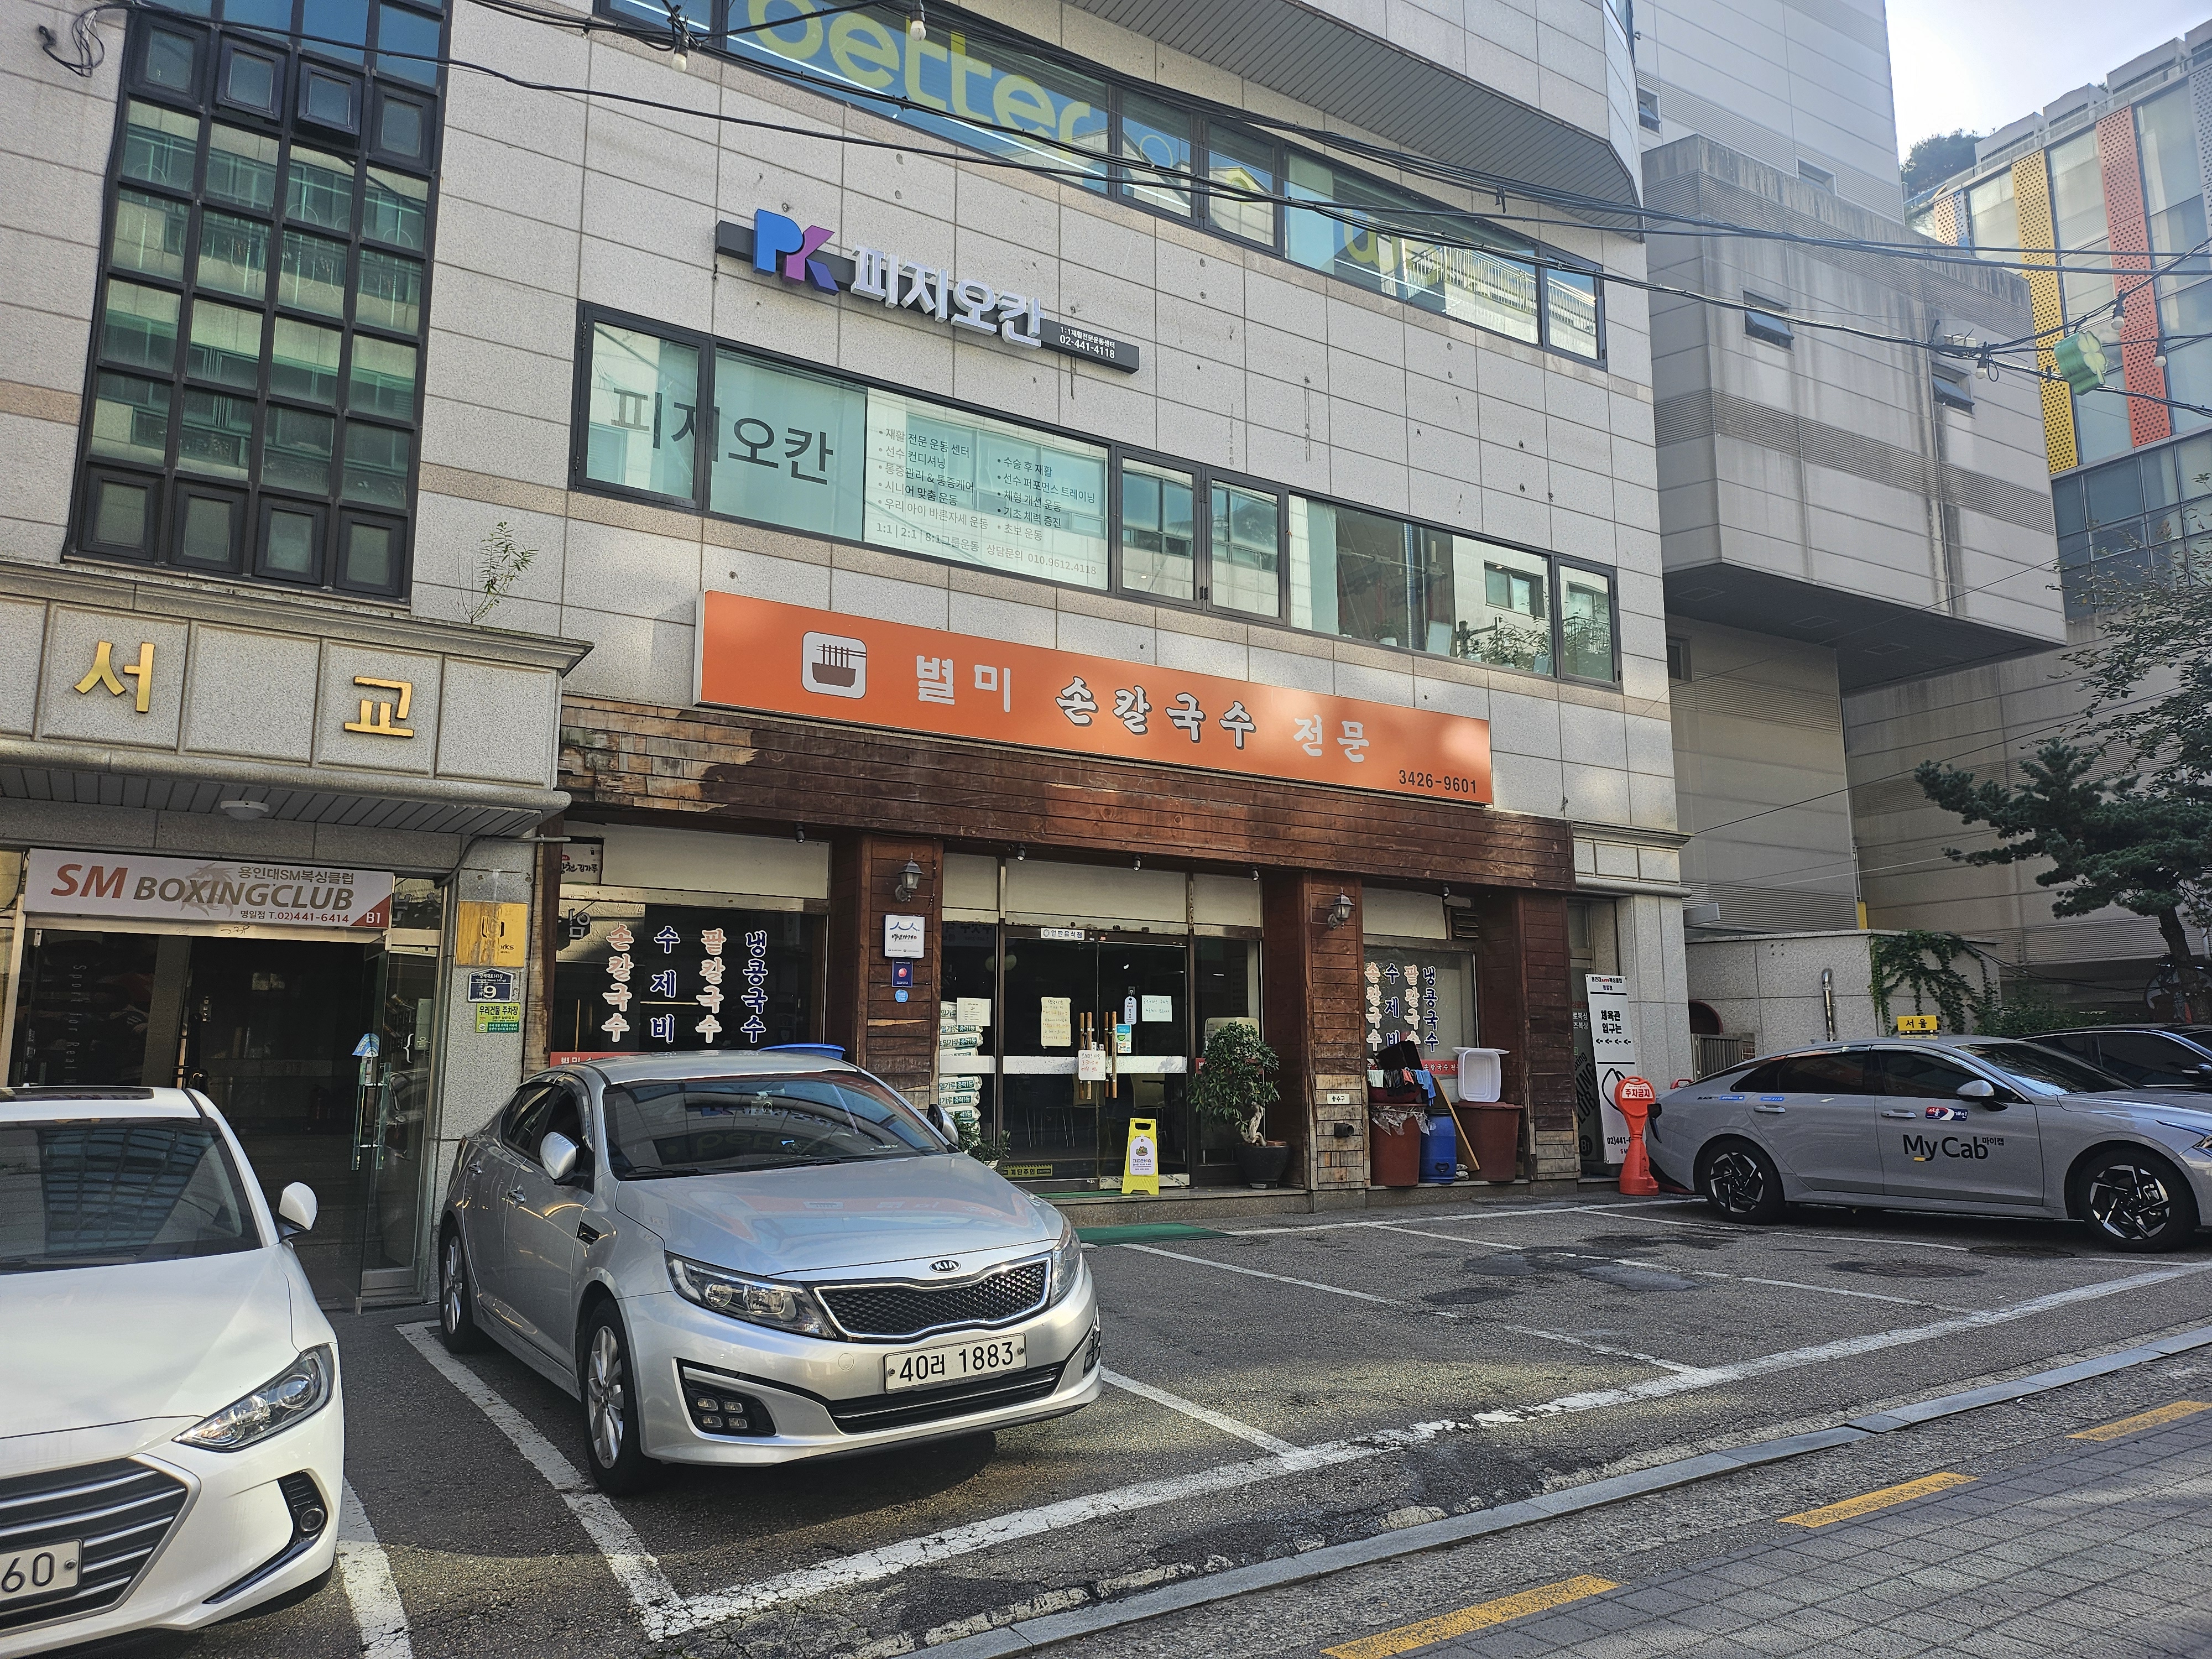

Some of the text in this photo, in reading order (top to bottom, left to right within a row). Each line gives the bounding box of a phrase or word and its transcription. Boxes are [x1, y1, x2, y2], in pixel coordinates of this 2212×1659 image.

[753, 208, 839, 296] PK
[851, 245, 1046, 350] 피지오칸
[1060, 335, 1115, 358] 02-441-4118
[611, 388, 833, 486] 피지오칸
[886, 429, 969, 458] 재활 전문 운동 센터
[885, 446, 946, 469] 선수 컨디셔닝
[1003, 457, 1052, 478] 수술 후 재활
[885, 462, 974, 494] 통증관리 & 통증케어
[1003, 473, 1095, 504] 선수 퍼포먼스 트레이닝
[885, 481, 958, 506] 시니어 맞춤 운동
[1004, 490, 1062, 512] 체형 개선 운동
[885, 498, 988, 530] 우리 아이 바른자세 운동
[1004, 507, 1061, 529] 기초 체력 증진
[1004, 524, 1042, 541] 초보 운동
[877, 523, 892, 534] 1:1
[901, 528, 917, 539] 2:1
[987, 544, 1023, 561] 상담문의
[1028, 554, 1097, 575] 010.9612.4118
[74, 640, 415, 738] 서 교
[916, 655, 1370, 763] 별미 손칼국수 전문
[1398, 769, 1478, 795] 3426-9601
[51, 864, 128, 899] SM
[238, 867, 354, 885] 용인대SM복싱클럽
[577, 864, 598, 873] 김가루
[133, 877, 354, 911] BOXINGCLUB
[240, 910, 265, 920] 명일점
[366, 912, 381, 924] B1
[1051, 930, 1082, 939] 일반음식점
[483, 985, 497, 998] 9
[601, 924, 635, 1043] 손칼국수
[649, 925, 681, 1044] 수제비
[695, 927, 727, 1044] 팥칼국수
[740, 930, 769, 1044] 냉콩국수
[479, 1006, 519, 1015] 우리건물 주차장
[1365, 962, 1383, 1051] 손칼국수
[1384, 963, 1400, 1046] 수제비
[1422, 966, 1439, 1052] 냉콩국수
[1601, 1010, 1620, 1021] 체육관
[1602, 1023, 1621, 1034] 입구는
[1906, 1019, 1927, 1028] 서울
[957, 1080, 973, 1088] 중력1등
[1625, 1089, 1650, 1098] 주차금지
[1903, 1134, 1988, 1161] My Cab
[1982, 1137, 2005, 1146] 마이캡
[935, 1261, 957, 1270] KIA
[958, 1341, 1014, 1373] 1883
